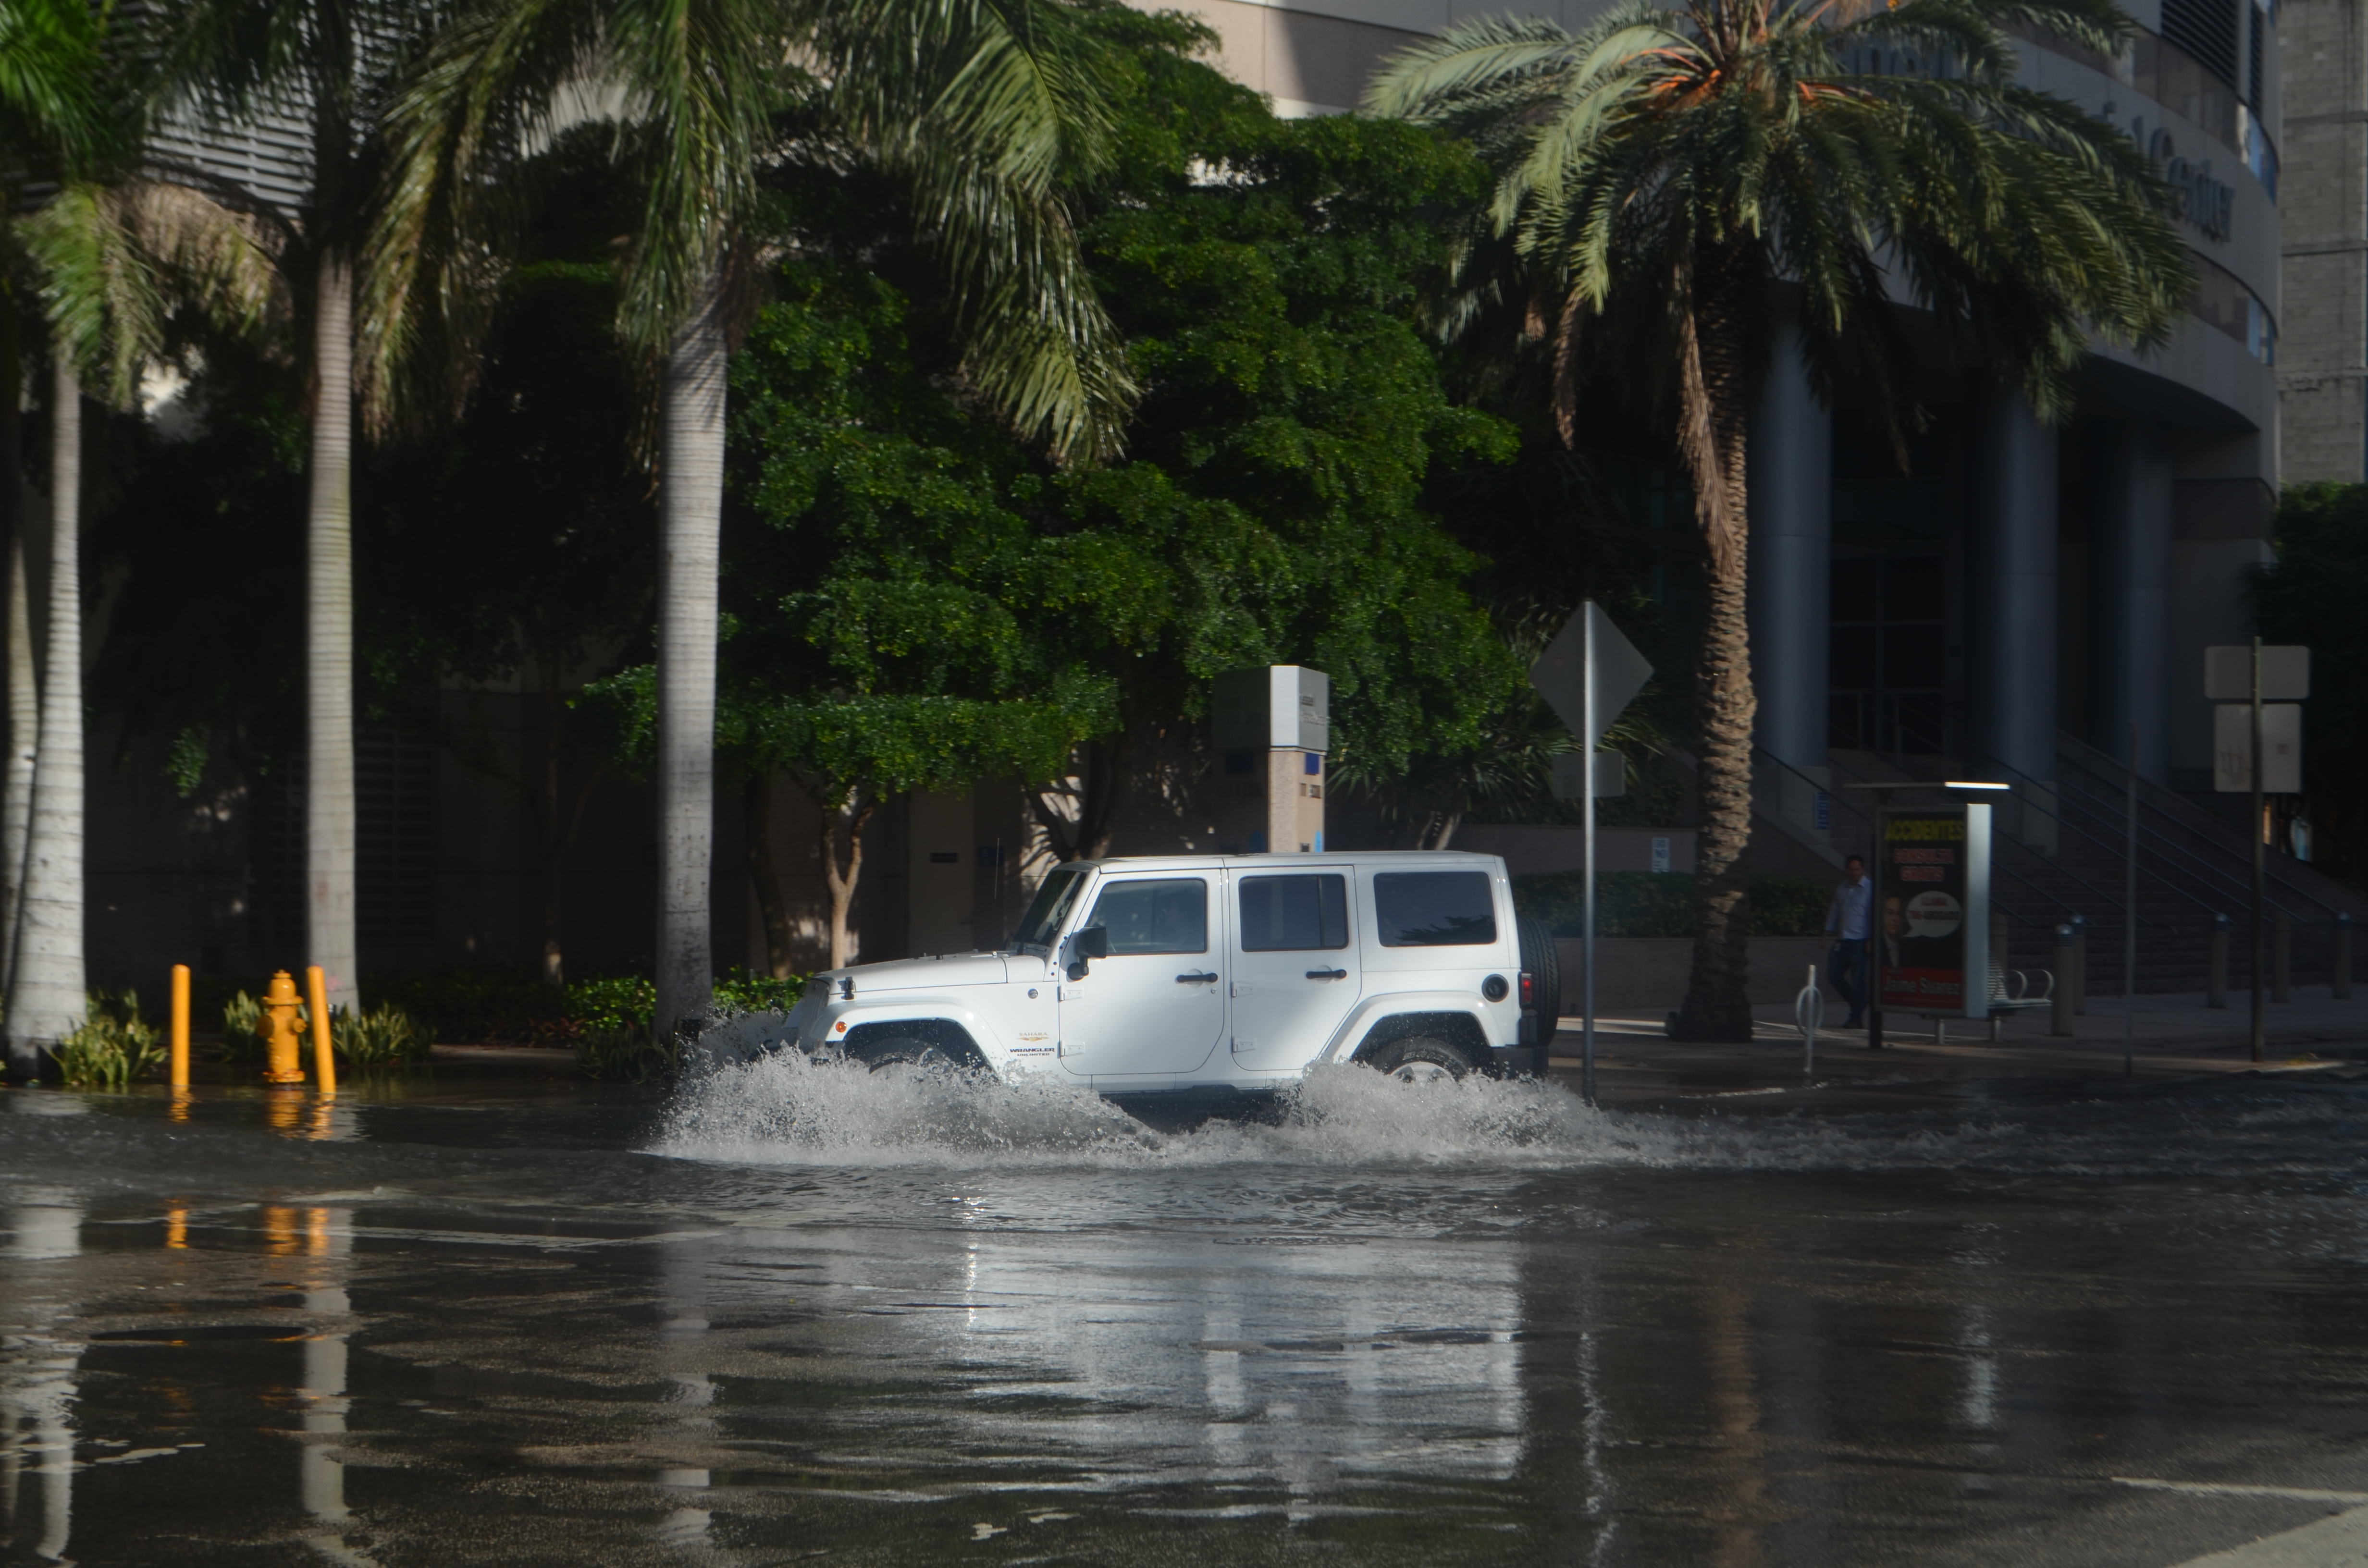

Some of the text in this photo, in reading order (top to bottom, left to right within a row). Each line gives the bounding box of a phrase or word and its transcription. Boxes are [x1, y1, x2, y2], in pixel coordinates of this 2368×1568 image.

[1884, 820, 1965, 841] ACCIDENTES
[1893, 848, 1956, 864] CONSULTA
[1900, 865, 1945, 882] GRATIS
[1883, 975, 1917, 993] Jaime
